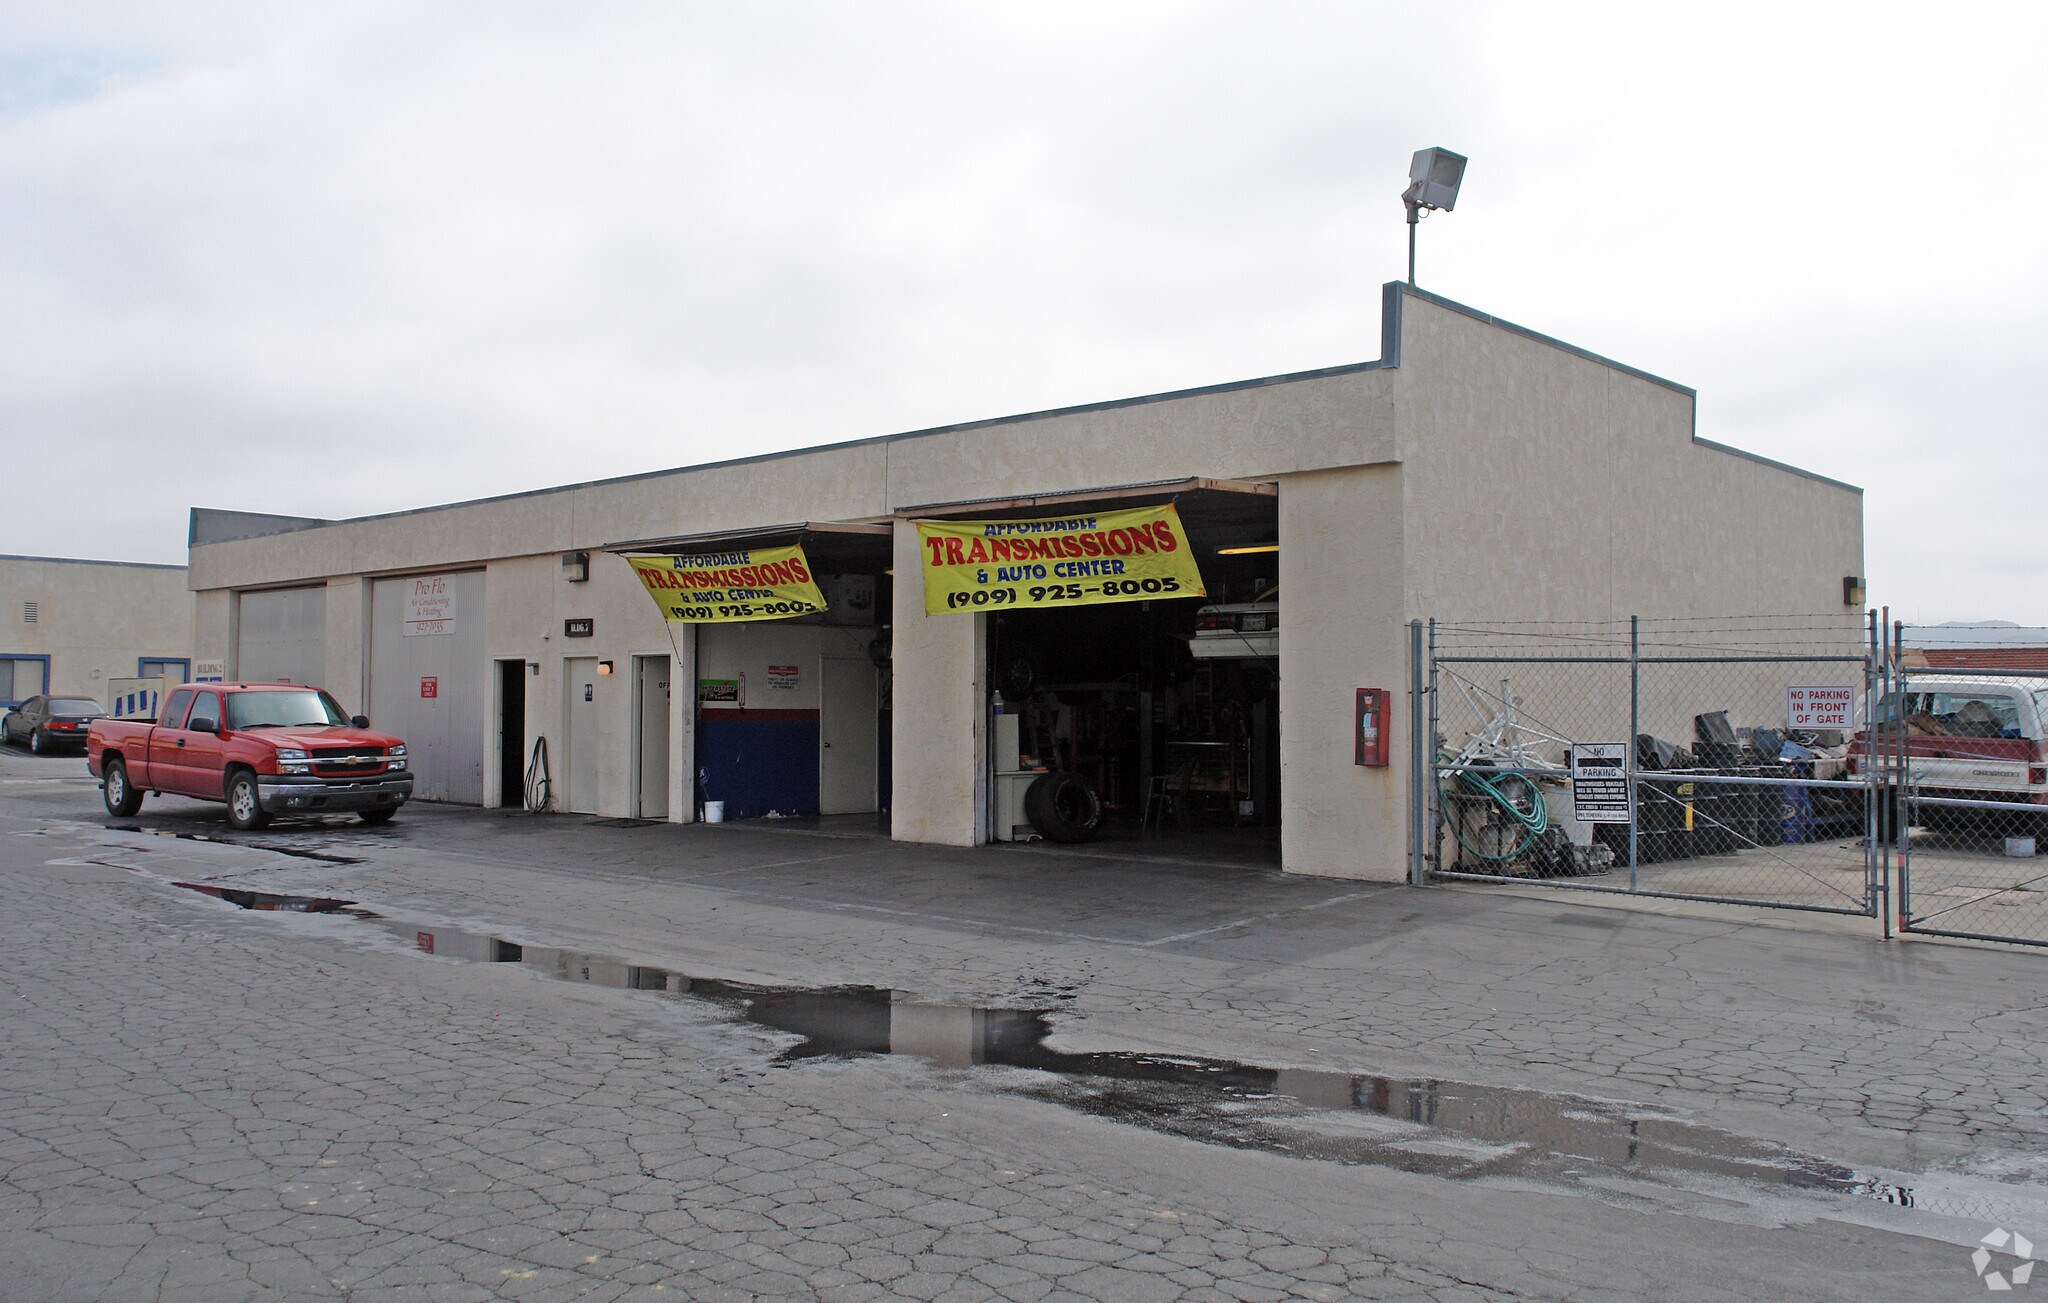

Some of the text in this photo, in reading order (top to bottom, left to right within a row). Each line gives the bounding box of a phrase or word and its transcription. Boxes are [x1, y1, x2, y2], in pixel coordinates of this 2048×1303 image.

[983, 517, 1097, 537] AFFORDABLE
[926, 520, 1178, 567] TRANSMISSIONS
[673, 551, 751, 569] AFFORDABLE
[638, 557, 810, 590] TRANSMISSIONS
[976, 559, 1126, 584] & AUTO CENTER
[414, 577, 447, 596] Pro Flo
[947, 577, 1181, 609] (909) 925-8005
[418, 597, 450, 608] Conditioning
[680, 588, 775, 603] & AUTO CENTER
[422, 607, 443, 618] Heating
[670, 600, 817, 619] (909) 925-8005
[1791, 690, 1850, 700] NO PARKING
[1792, 702, 1848, 712] IN FRONT
[1796, 714, 1845, 724] OF GATE
[1593, 747, 1605, 757] NO
[1582, 768, 1617, 777] PARKING
